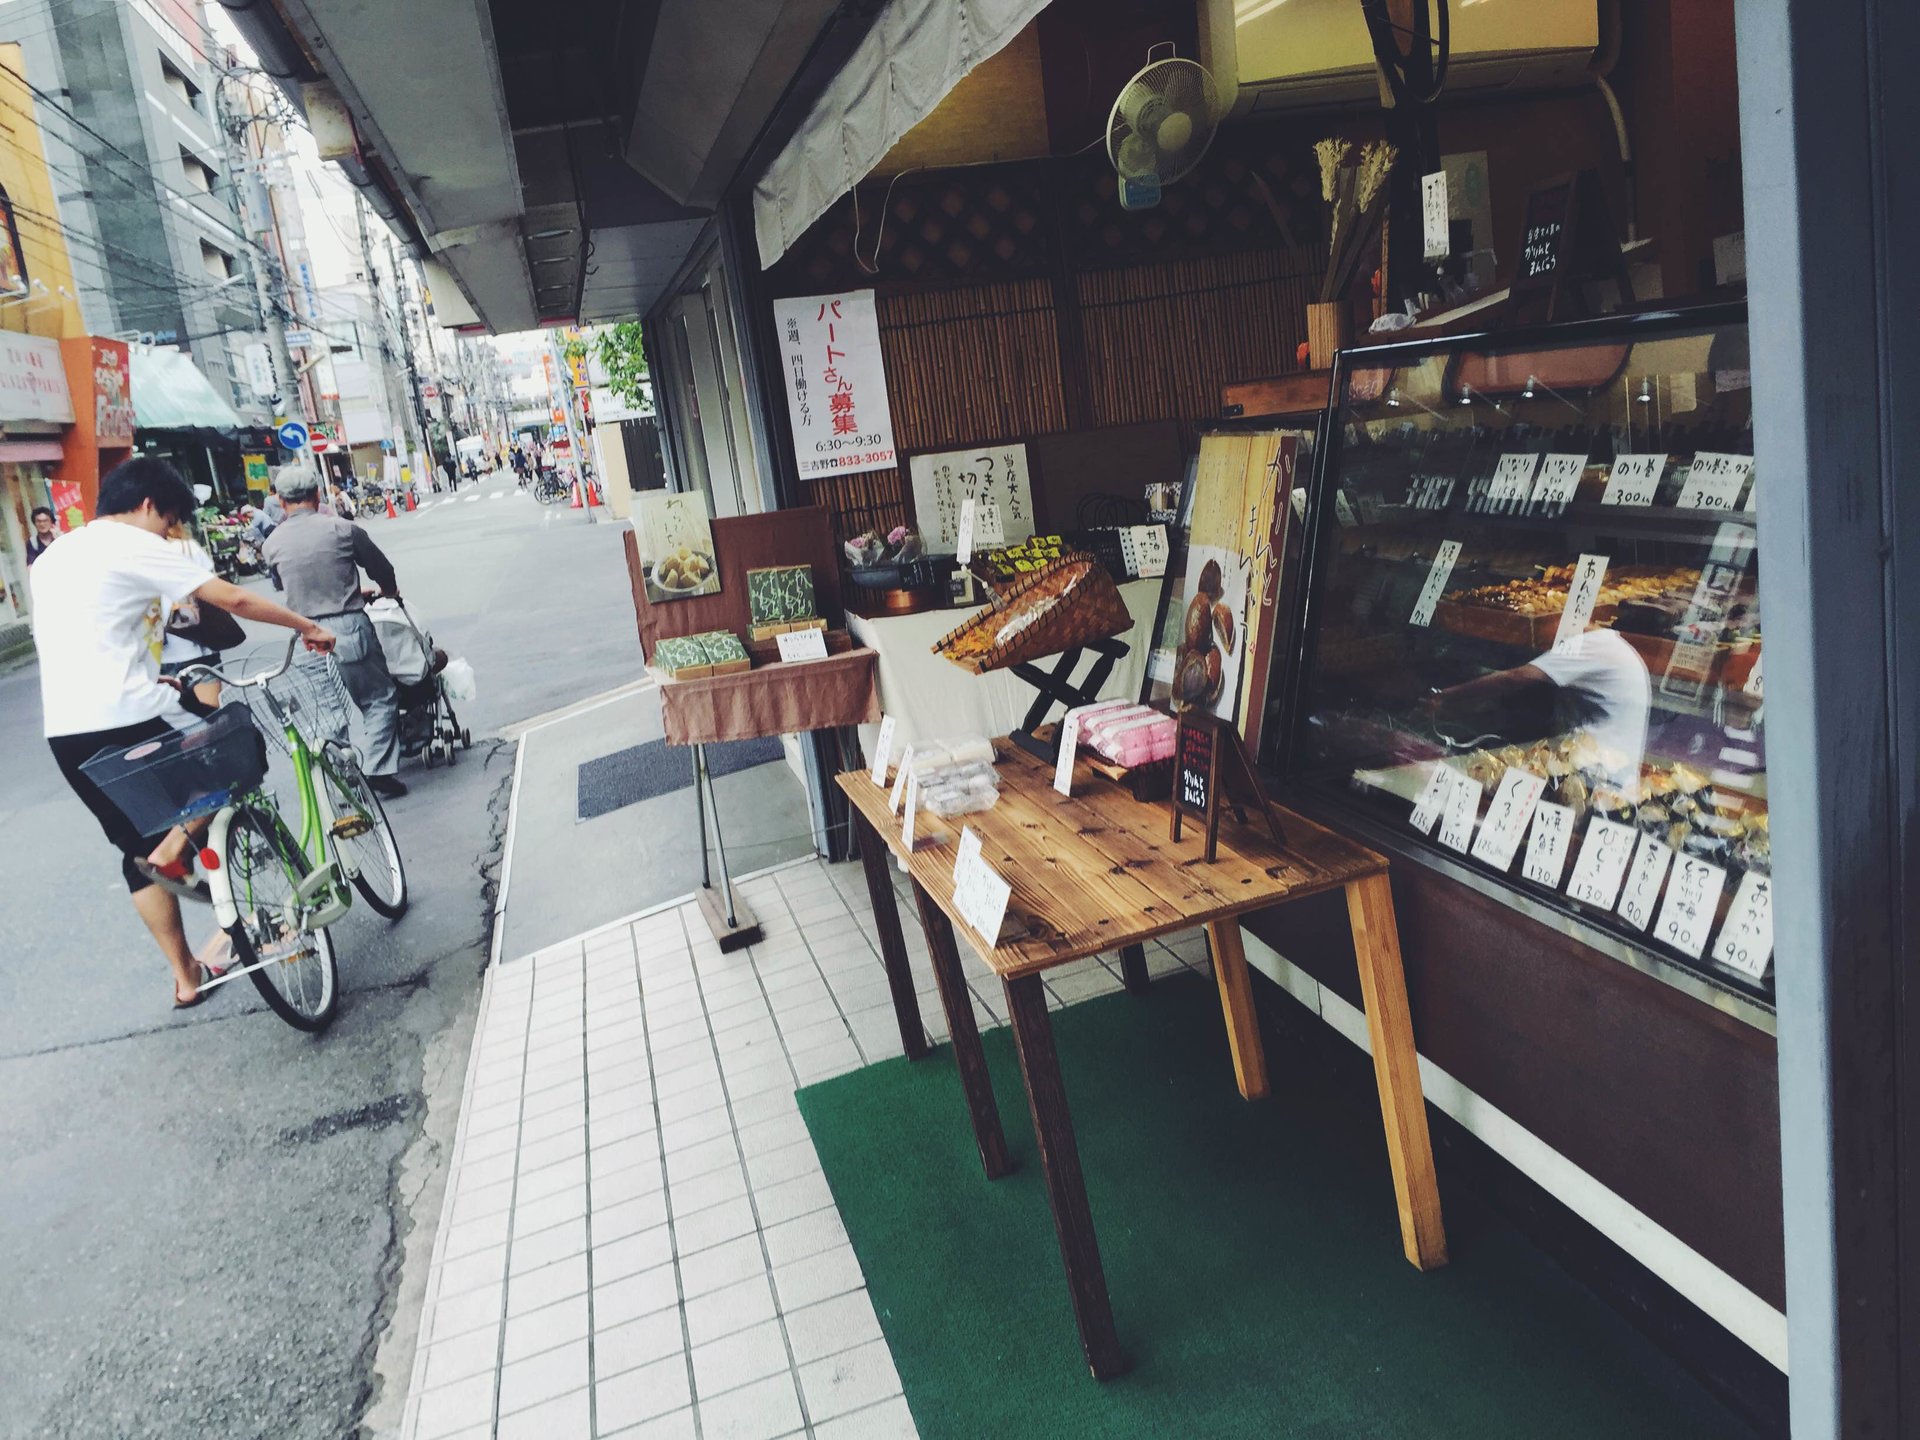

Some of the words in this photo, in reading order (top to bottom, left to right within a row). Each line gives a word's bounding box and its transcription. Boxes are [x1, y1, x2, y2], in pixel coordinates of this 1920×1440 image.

[1525, 241, 1551, 261] かりんと
[1529, 254, 1557, 277] まんじゅう
[817, 300, 858, 436] パートさん募集
[838, 451, 893, 467] 833-3057
[1617, 458, 1656, 479] のり巻
[1263, 446, 1291, 606] かりんと
[1184, 768, 1204, 791] かりんと
